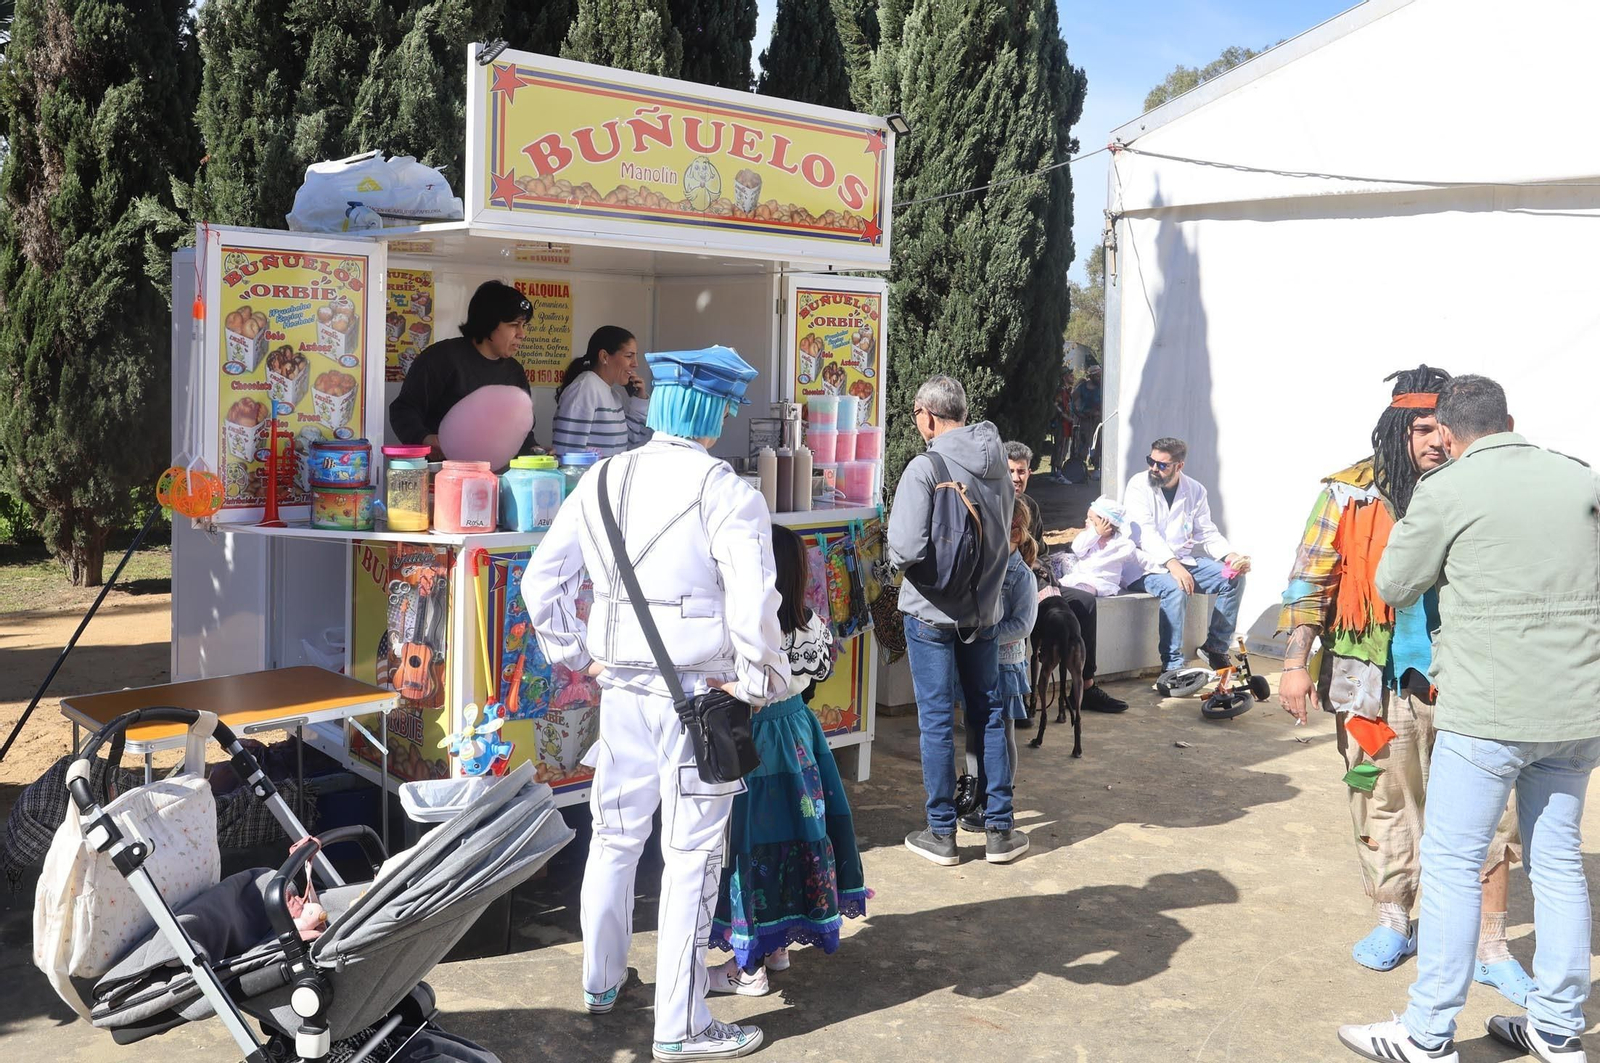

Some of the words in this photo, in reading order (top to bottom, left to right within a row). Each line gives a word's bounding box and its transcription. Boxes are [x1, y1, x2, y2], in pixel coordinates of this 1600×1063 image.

[522, 105, 870, 211] BUÑUELOS
[621, 162, 678, 186] Manolin
[223, 254, 364, 292] BUÑUELOS
[514, 281, 526, 296] SE
[529, 282, 570, 298] ALQUILA
[799, 294, 880, 321] BUÑUELOS
[527, 358, 561, 366] Palomitas
[537, 370, 552, 383] 150
